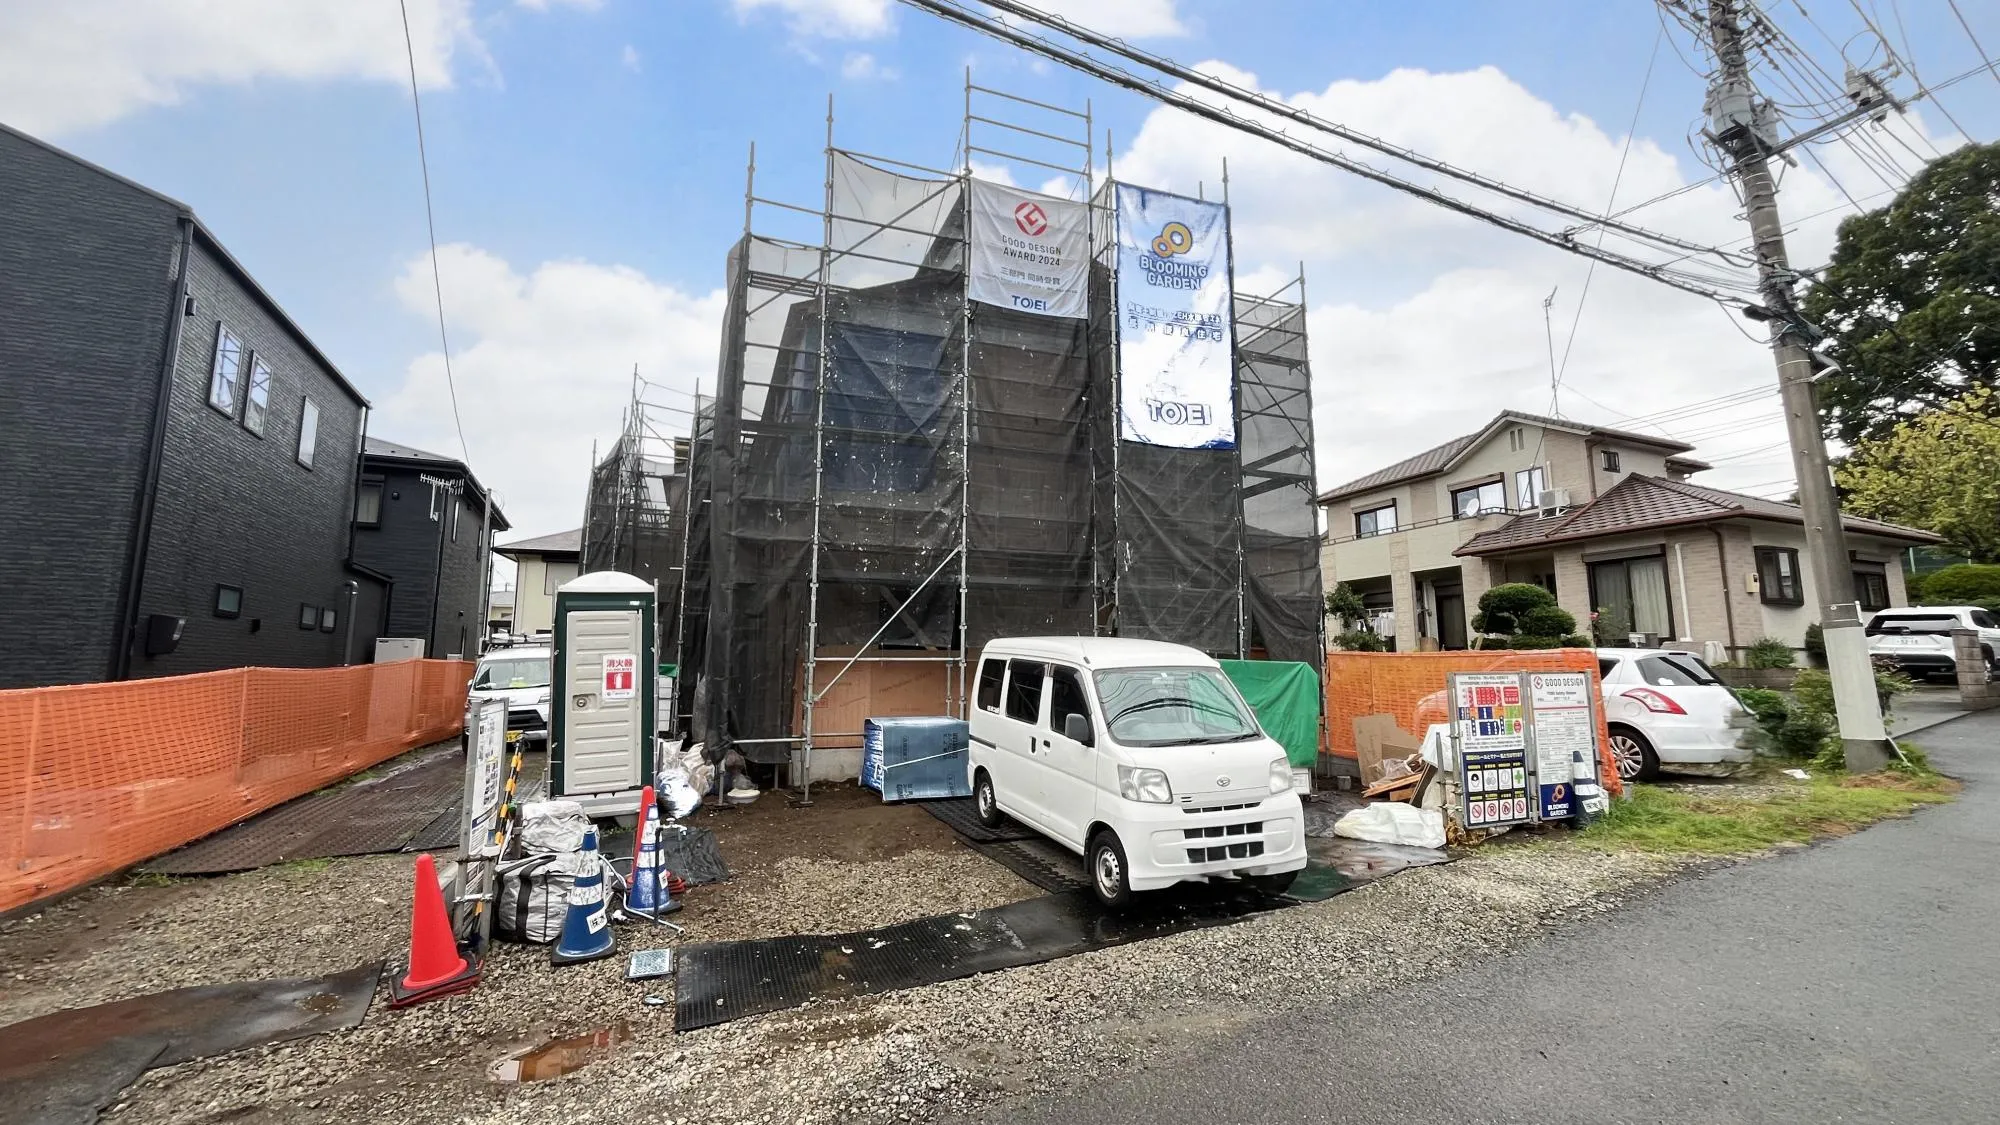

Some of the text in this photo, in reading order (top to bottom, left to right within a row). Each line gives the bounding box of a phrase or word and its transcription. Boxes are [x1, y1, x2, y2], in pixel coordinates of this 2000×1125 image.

[1002, 235, 1062, 256] GOOD DESIGN
[1003, 247, 1060, 266] AWARD 2024
[1140, 255, 1208, 278] BLOOMING
[1147, 272, 1201, 291] GARDEN
[606, 658, 633, 668] 消火器
[1544, 678, 1584, 687] GOOD DESIGN
